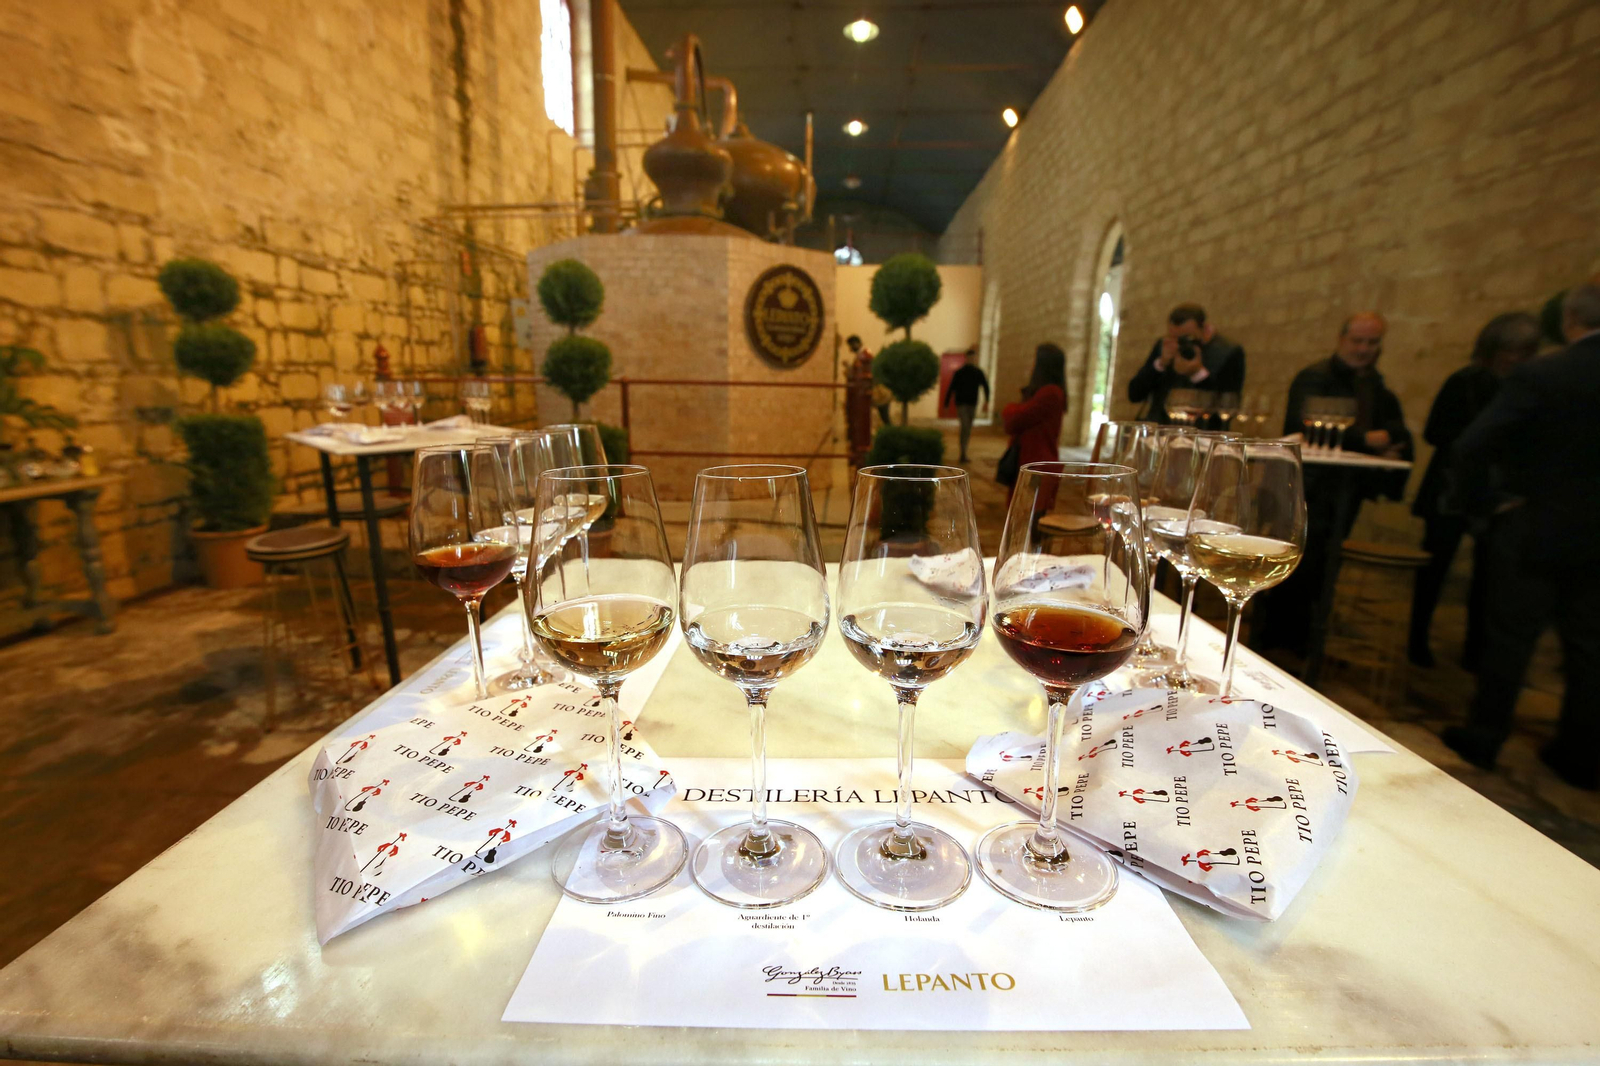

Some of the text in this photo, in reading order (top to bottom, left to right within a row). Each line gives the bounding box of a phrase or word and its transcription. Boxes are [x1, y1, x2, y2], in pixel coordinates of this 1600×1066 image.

[558, 682, 582, 694] EPE
[468, 705, 525, 732] TIO PEPE
[552, 702, 571, 713] TIO
[409, 717, 436, 729] EPE
[1081, 724, 1093, 742] TIO
[393, 744, 454, 774] TIO PEPE
[489, 745, 551, 766] TIO PEPE
[580, 733, 645, 761] TIO EPE
[1122, 725, 1134, 768] TIO PEPE
[1216, 723, 1238, 776] TIO PEPE
[1070, 772, 1090, 820] TIO PEPE
[1332, 770, 1348, 796] TIO
[409, 792, 477, 822] TIO PEPE
[514, 784, 587, 814] TIO EPE
[1173, 775, 1191, 827] TIO PEPE
[1285, 778, 1313, 844] TIO PEPE
[1123, 820, 1138, 852] EPE
[432, 845, 486, 877] TIO PE
[1241, 829, 1266, 905] TIO PEPE
[329, 876, 353, 896] TIO
[751, 922, 795, 930] destilación
[1059, 915, 1094, 923] Lepanto
[882, 972, 1016, 991] LEPANTO
